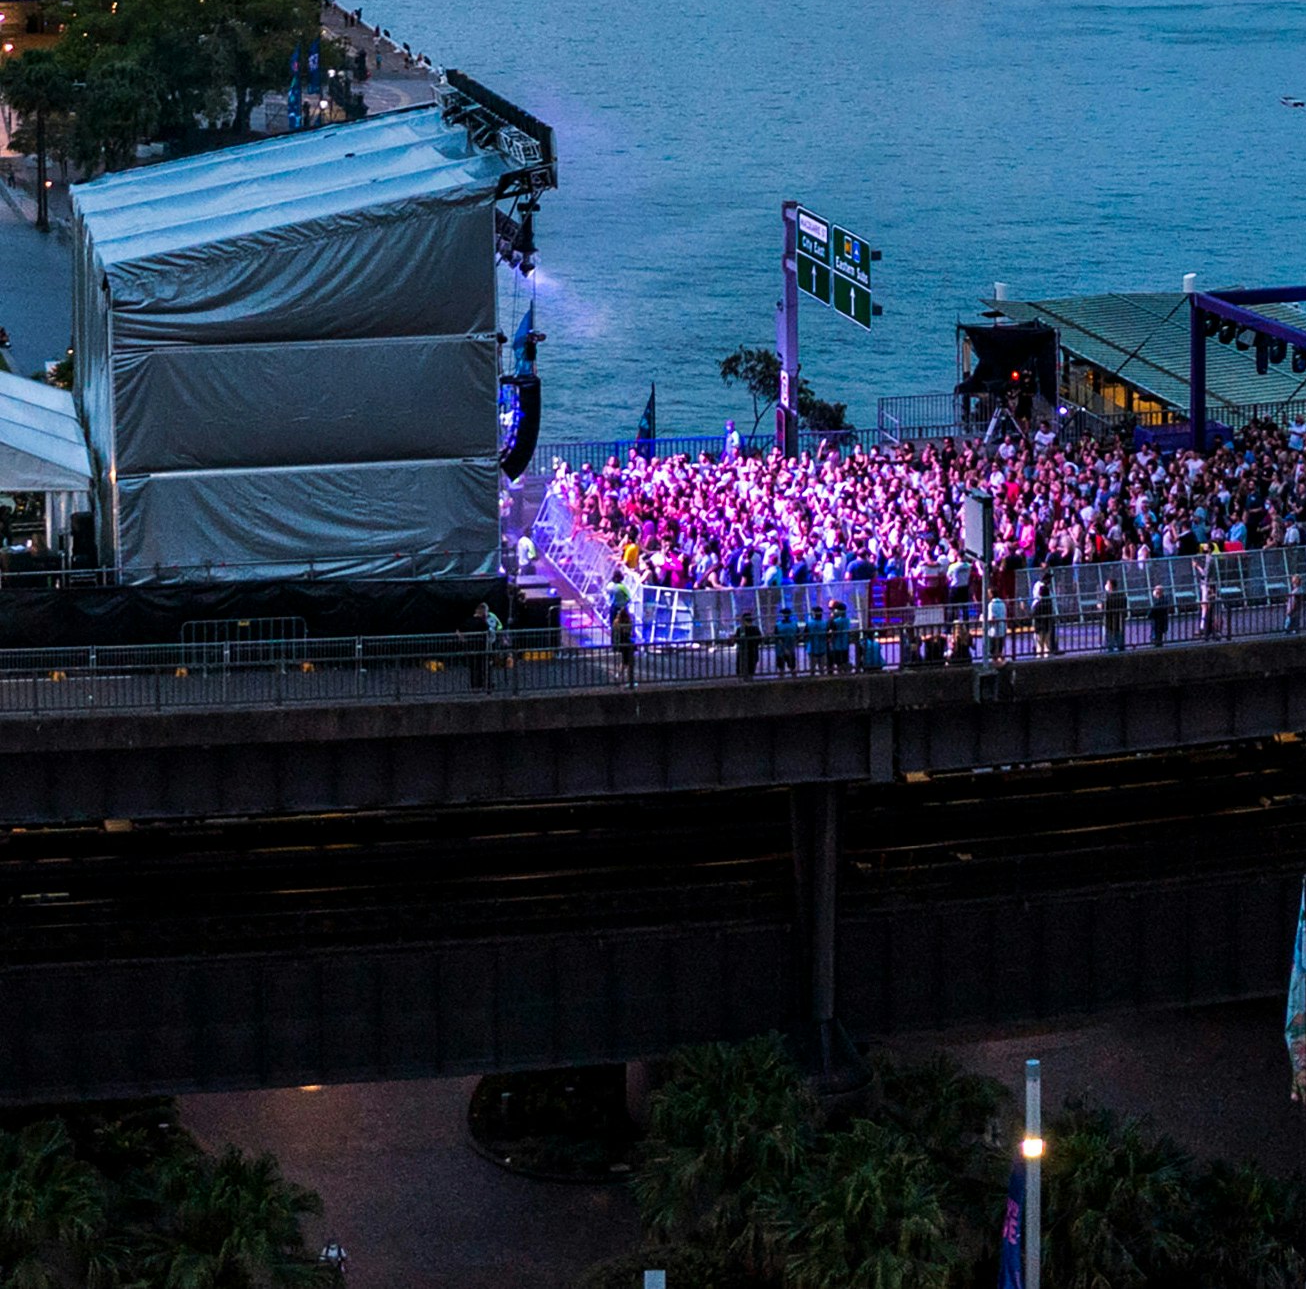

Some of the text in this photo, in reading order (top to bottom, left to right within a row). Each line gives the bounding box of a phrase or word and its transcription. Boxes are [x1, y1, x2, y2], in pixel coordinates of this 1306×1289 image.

[802, 235, 825, 258] City East
[835, 255, 869, 285] Eastern Subs
